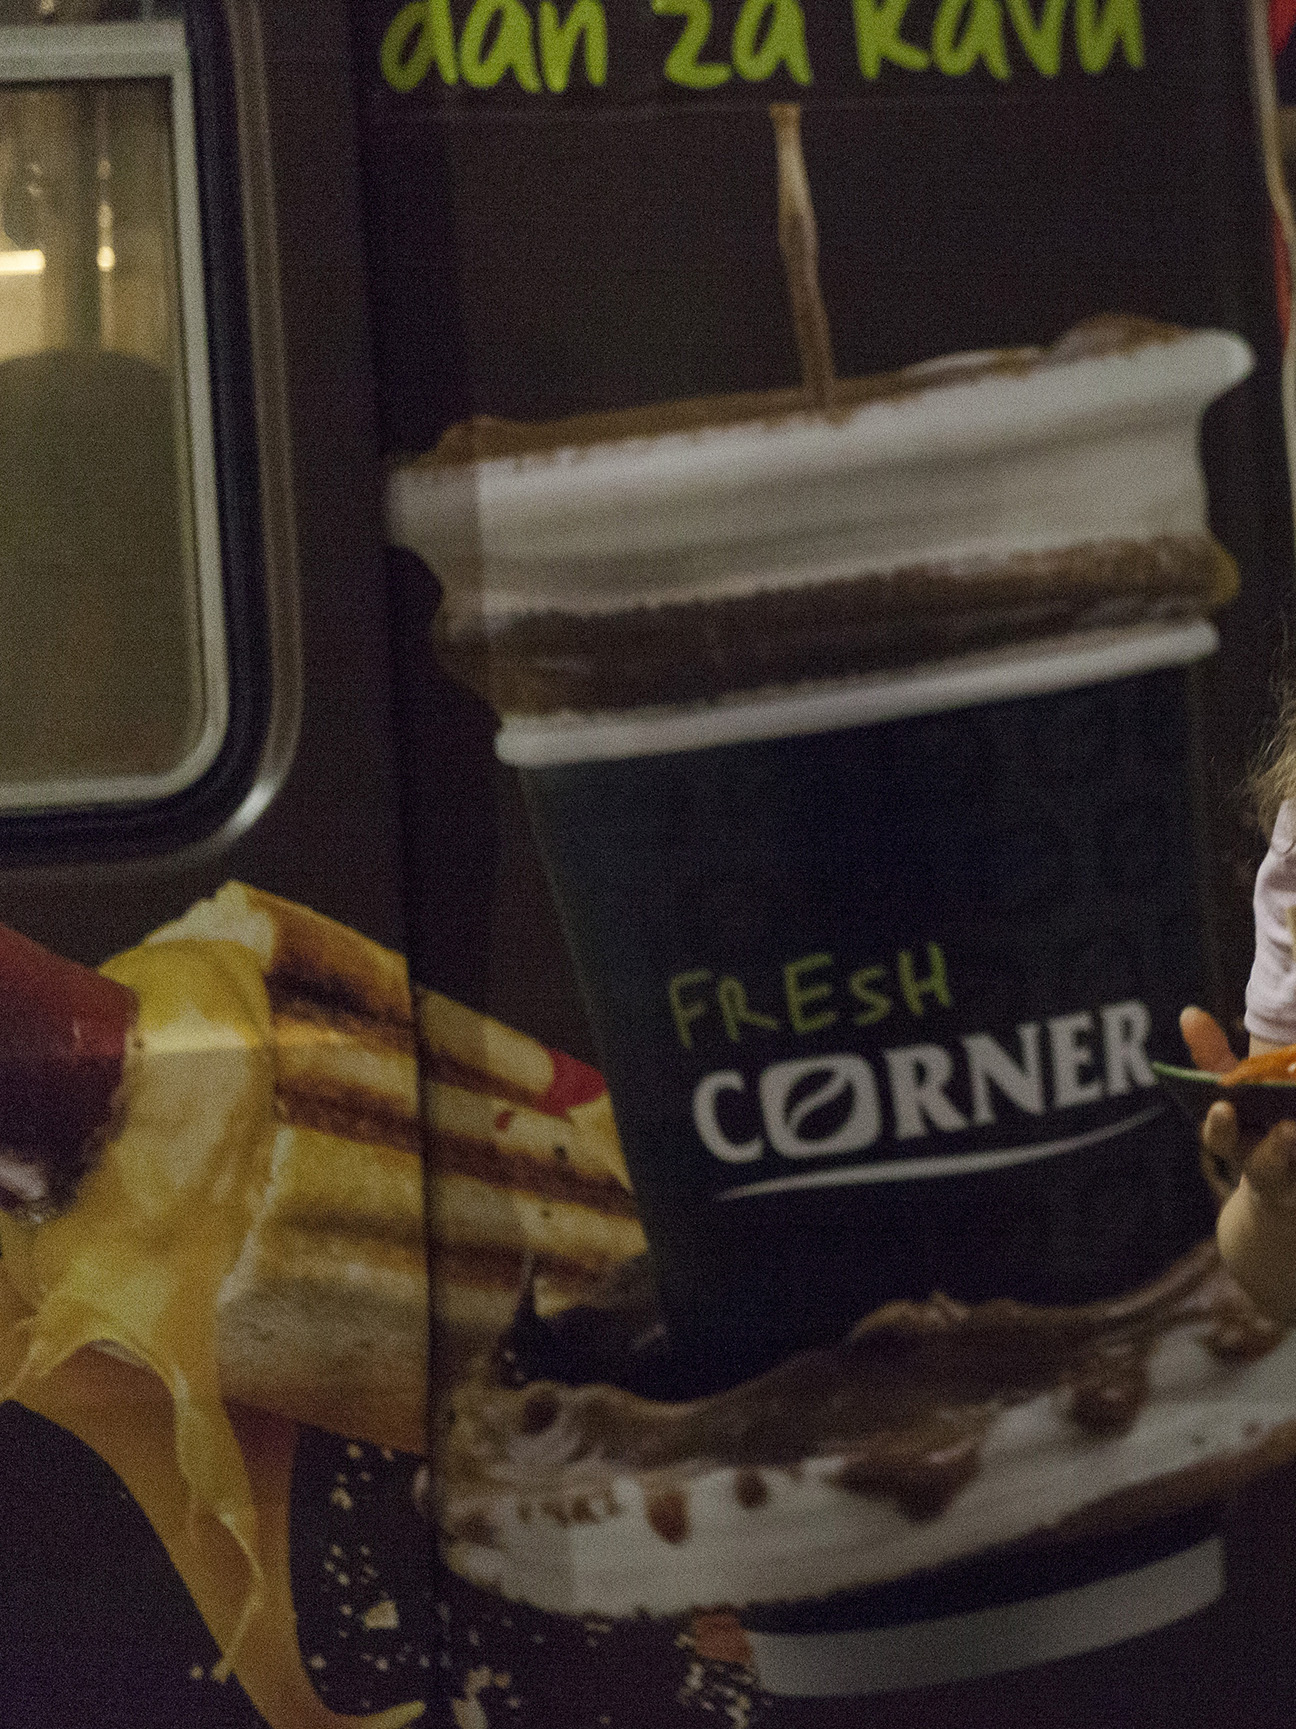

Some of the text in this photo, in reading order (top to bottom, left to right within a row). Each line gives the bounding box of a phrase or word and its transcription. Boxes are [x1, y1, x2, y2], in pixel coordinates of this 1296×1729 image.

[379, 0, 608, 93] dan
[651, 0, 814, 88] za
[668, 942, 952, 1049] FRESH
[693, 1000, 1158, 1163] CORNER
